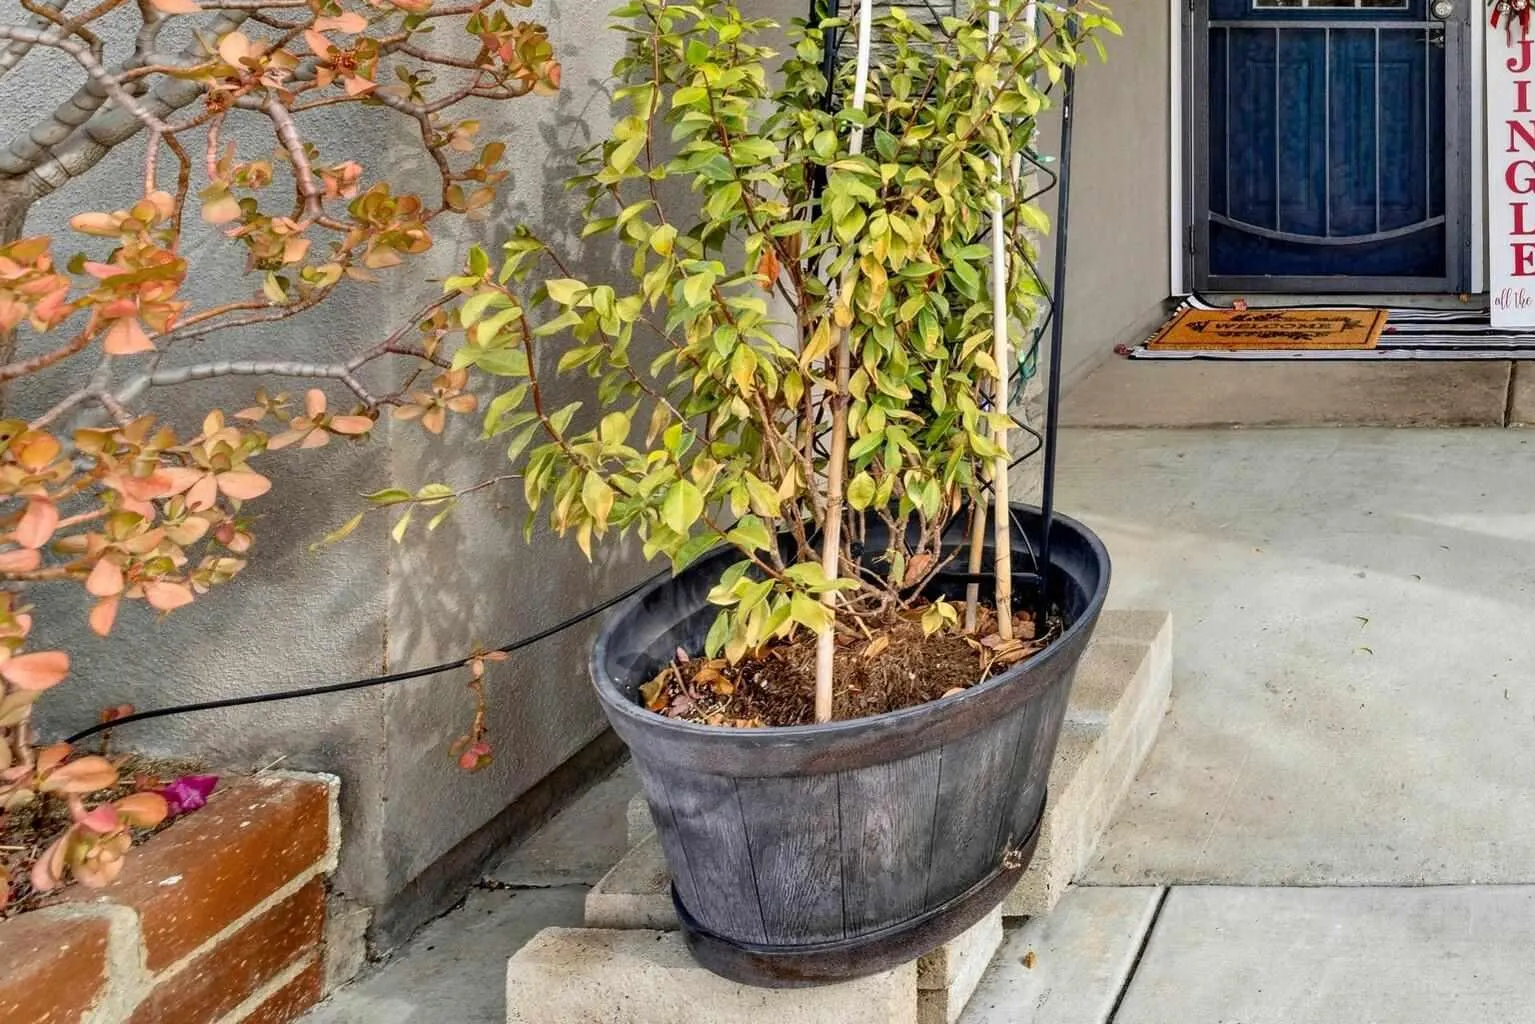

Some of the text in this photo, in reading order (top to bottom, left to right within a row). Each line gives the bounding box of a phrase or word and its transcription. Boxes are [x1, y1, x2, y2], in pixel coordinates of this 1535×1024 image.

[1494, 287, 1512, 310] all
[1514, 287, 1533, 309] the
[1214, 322, 1333, 332] WELCOME
